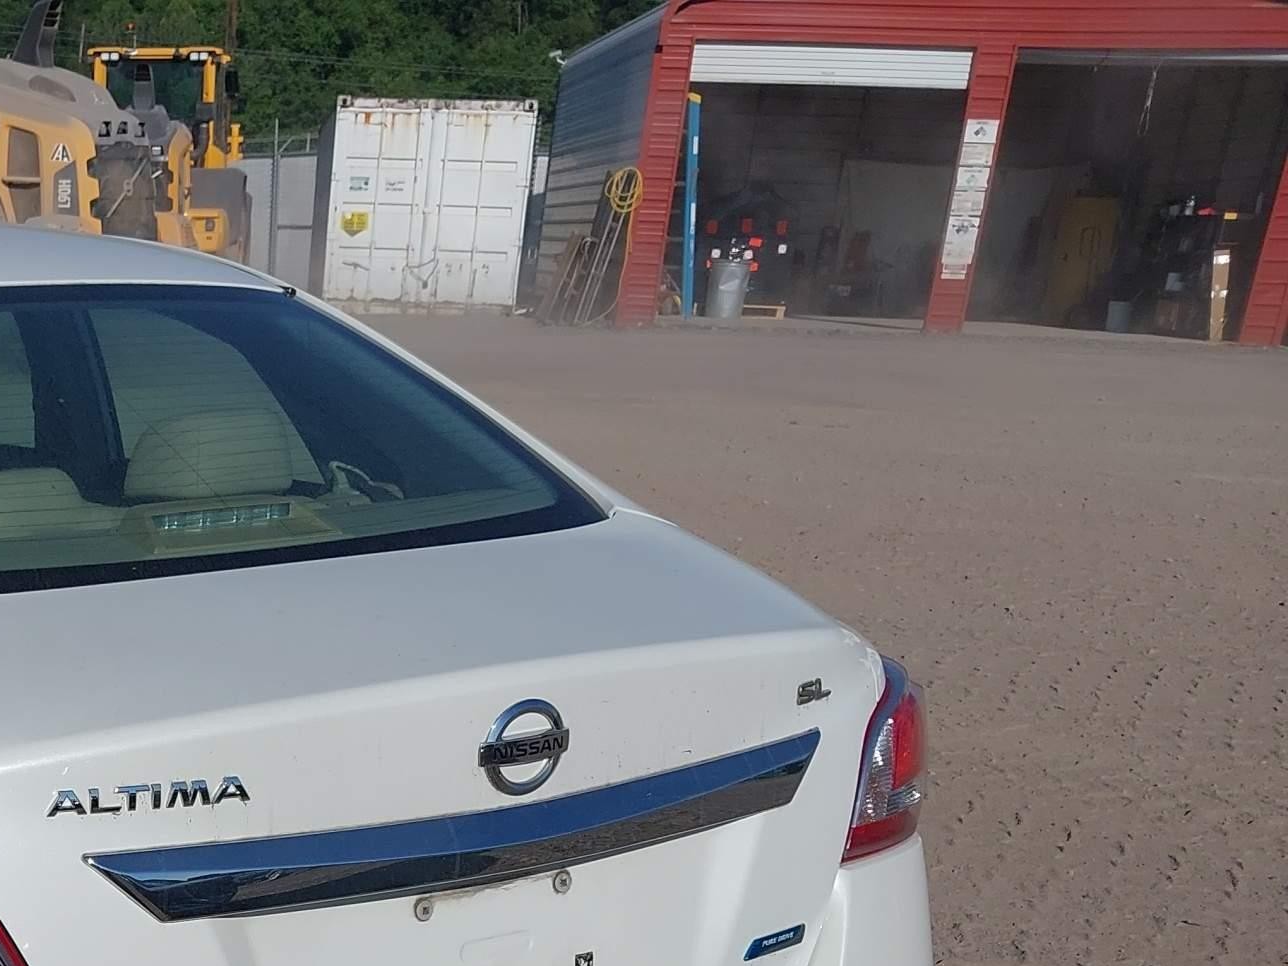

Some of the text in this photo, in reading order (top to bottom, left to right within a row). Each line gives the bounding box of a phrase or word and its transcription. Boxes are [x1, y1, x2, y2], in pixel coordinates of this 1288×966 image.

[797, 677, 832, 705] SL
[493, 735, 564, 759] NISSAN
[45, 775, 251, 818] ALTIMA
